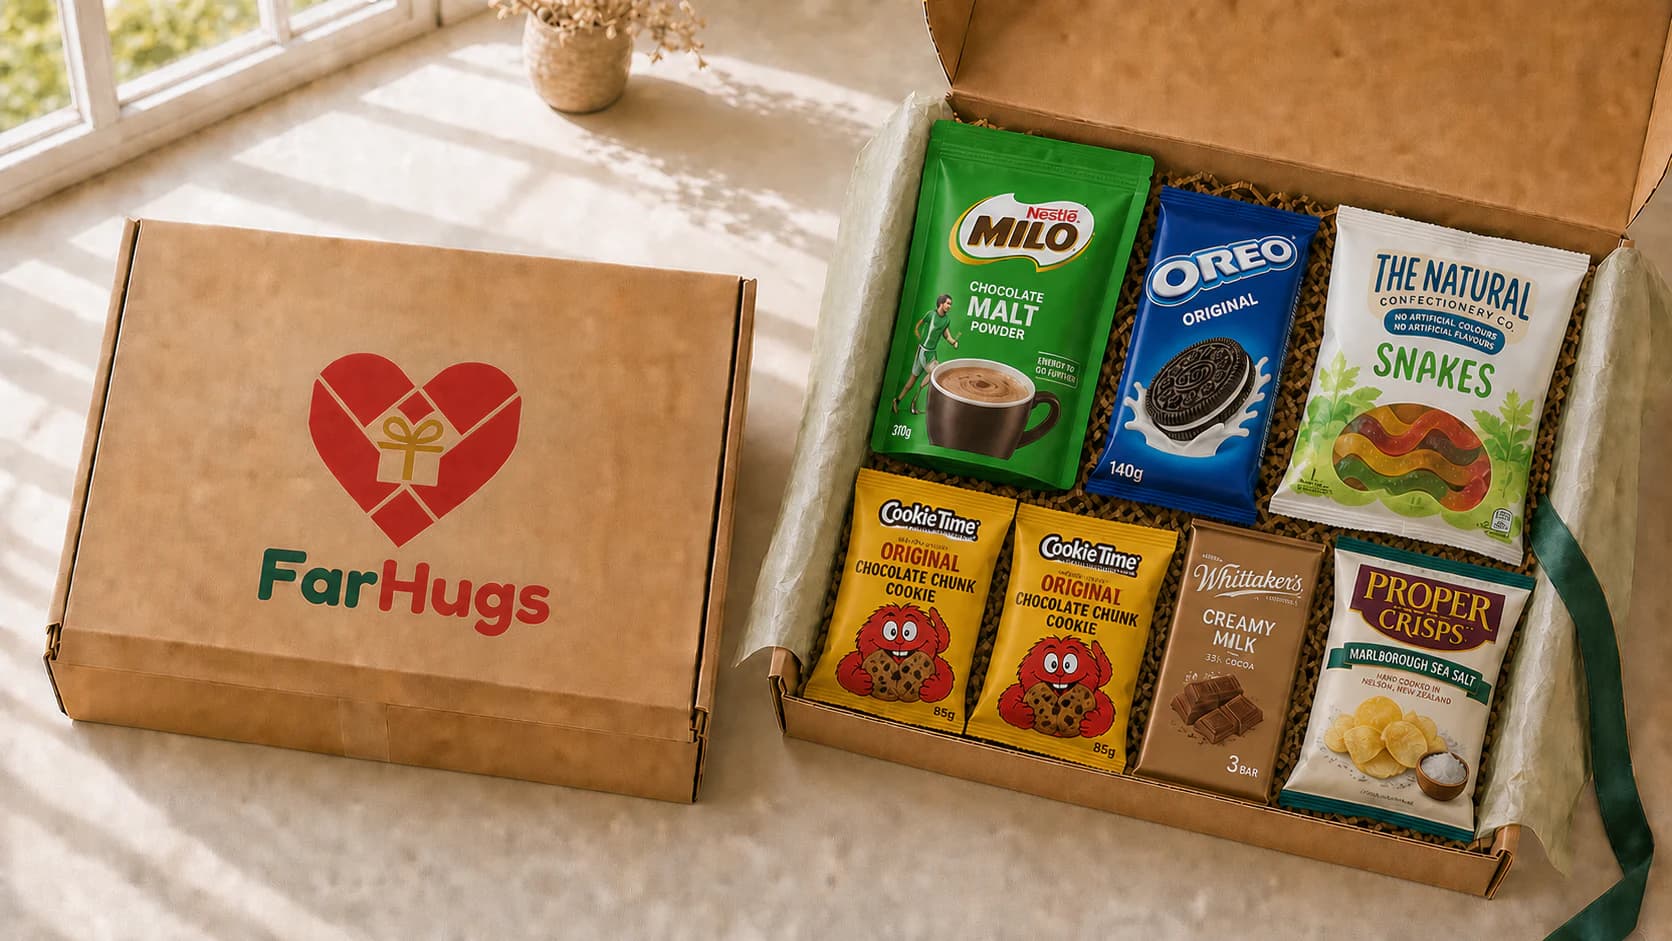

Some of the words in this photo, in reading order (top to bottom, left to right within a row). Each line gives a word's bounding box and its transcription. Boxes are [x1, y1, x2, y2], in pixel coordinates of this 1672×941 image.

[966, 215, 1080, 253] MILO
[1150, 237, 1294, 299] OREO
[969, 280, 1045, 304] CHOCOLATE
[1374, 253, 1421, 293] THE
[1423, 259, 1531, 321] NATURAL
[966, 295, 1040, 327] MALT
[1182, 292, 1259, 327] ORIGINAL
[1379, 295, 1494, 320] CONFECTIONERY
[1496, 316, 1515, 333] CO.
[970, 320, 1026, 341] POWDER
[1393, 323, 1407, 331] NO
[1408, 323, 1453, 337] ARTIFICIAL
[1453, 330, 1495, 350] FLAVOURS
[1394, 313, 1408, 321] NO
[1409, 313, 1456, 327] ARTIFICIAL
[1458, 321, 1498, 341] COLOURS
[1066, 363, 1076, 374] TO
[1373, 342, 1496, 399] SNAKES
[891, 424, 912, 440] 310g
[1108, 460, 1144, 483] 140g
[880, 541, 960, 573] ORIGINAL
[855, 559, 929, 585] CHOCOLATE
[930, 572, 977, 594] CHUNK
[1040, 574, 1121, 606] ORIGINAL
[1193, 563, 1303, 593] Whittaker's
[257, 547, 551, 637] FarHugs
[885, 581, 937, 603] COOKIE
[1363, 570, 1493, 632] PROPER
[1015, 591, 1090, 617] CHOCOLATE
[1092, 605, 1140, 628] CHUNK
[1202, 608, 1277, 637] CREAMY
[1046, 614, 1098, 636] COOKIE
[1378, 608, 1465, 646] CRISPS
[1212, 629, 1257, 654] MILK
[1225, 657, 1255, 670] COCOA
[1349, 647, 1429, 672] MARLBOROUGH
[1430, 661, 1450, 679] SEA
[1451, 669, 1477, 688] SALT
[1396, 686, 1415, 696] NEW
[1416, 691, 1452, 705] ZEALAND
[1431, 685, 1441, 694] IN
[933, 705, 956, 722] 85g
[1092, 741, 1116, 759] 85g
[1226, 754, 1240, 773] 3
[1239, 764, 1259, 778] BAR
